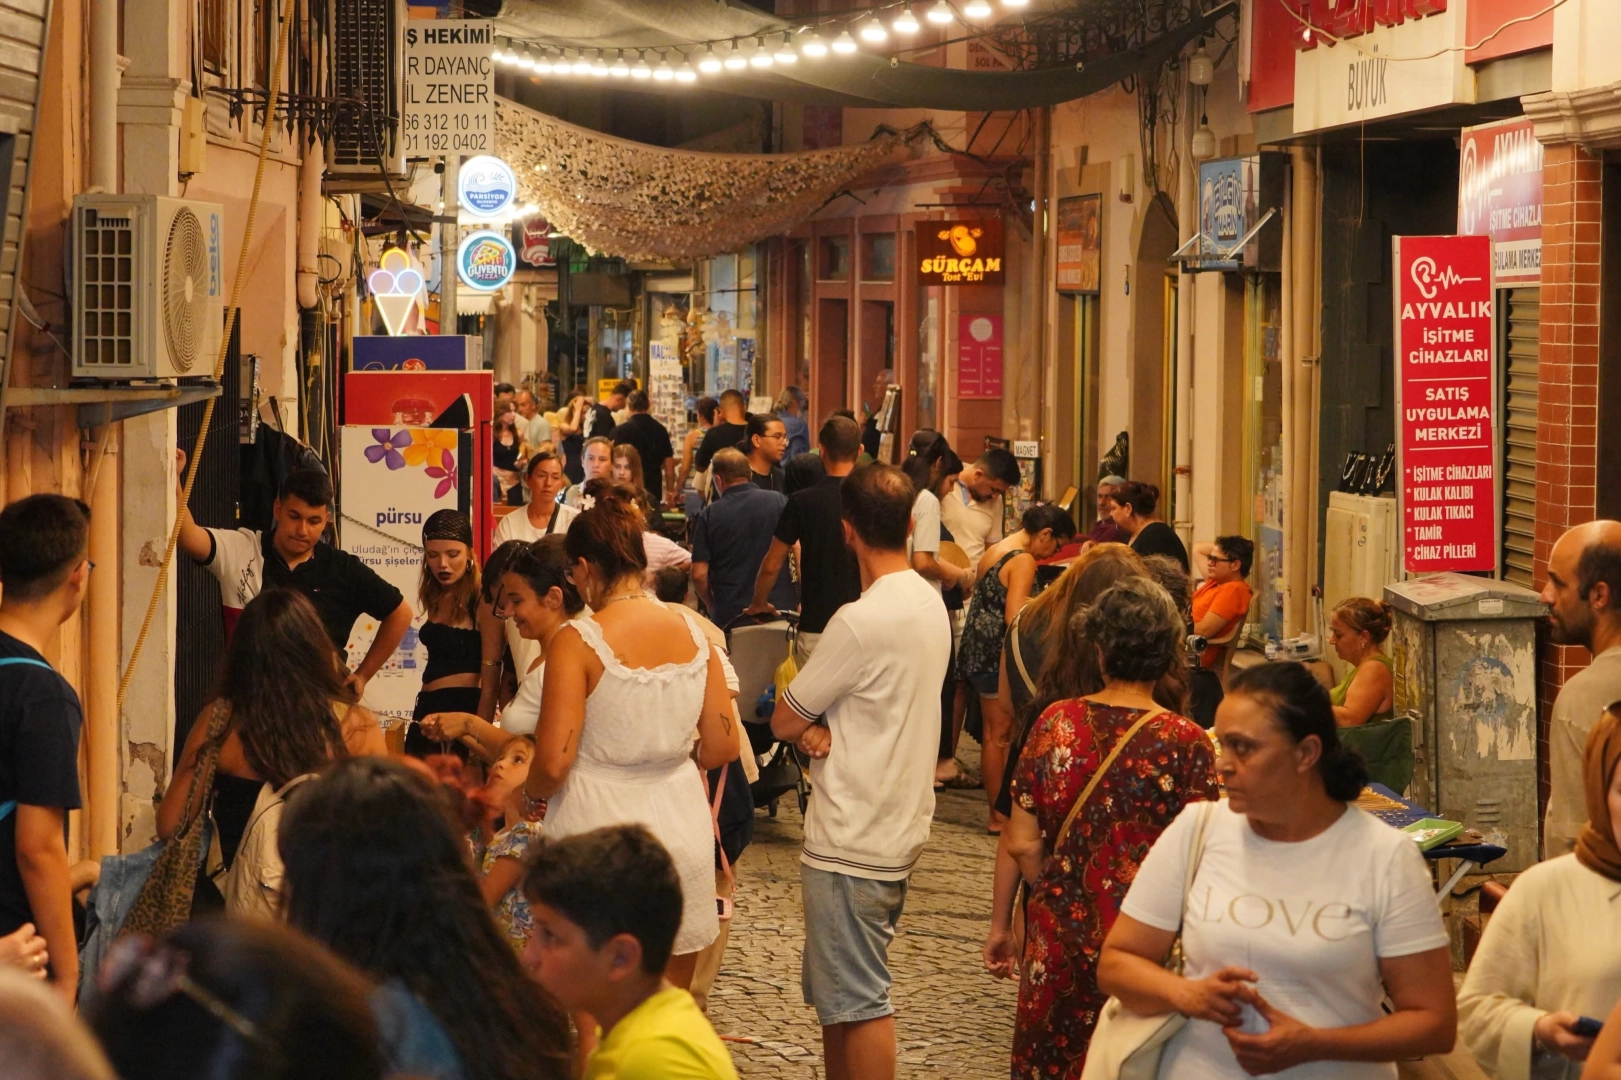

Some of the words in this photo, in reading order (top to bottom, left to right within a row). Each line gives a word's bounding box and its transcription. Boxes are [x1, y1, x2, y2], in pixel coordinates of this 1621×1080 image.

[424, 24, 491, 44] HEKİMİ
[425, 56, 491, 80] DAYANÇ
[1347, 44, 1387, 111] BÜYÜK
[426, 84, 489, 104] ZENER
[424, 113, 448, 130] 312
[454, 113, 469, 130] 10
[474, 113, 487, 130] 11
[425, 133, 448, 150] 192
[453, 133, 487, 150] 0402
[470, 192, 505, 200] PANSİYON
[1489, 204, 1512, 235] İŞİTME
[209, 213, 218, 296] beko
[467, 264, 509, 278] OLIVENTO
[920, 255, 1001, 276] SÜRÇAM
[942, 272, 961, 282] Tost
[966, 272, 984, 281] Evi
[1401, 301, 1492, 320] AYVALIK
[1423, 327, 1474, 345] İŞİTME
[1409, 347, 1488, 364] CİHAZLARI
[1425, 387, 1469, 401] SATIŞ
[1406, 406, 1490, 421] UYGULAMA
[1415, 423, 1481, 441] MERKEZİ
[1015, 445, 1037, 456] MAGNET
[1413, 465, 1444, 483] İŞİTME
[1446, 464, 1492, 480] CİHAZLARI
[1413, 487, 1443, 501] KULAK
[1445, 486, 1474, 500] KALIBI
[376, 507, 422, 527] pürsu
[1414, 506, 1443, 521] KULAK
[1445, 505, 1474, 519] TIKACI
[1414, 524, 1443, 540] TAMİR
[1414, 544, 1441, 560] CİHAZ
[1443, 542, 1476, 558] PİLLERİ
